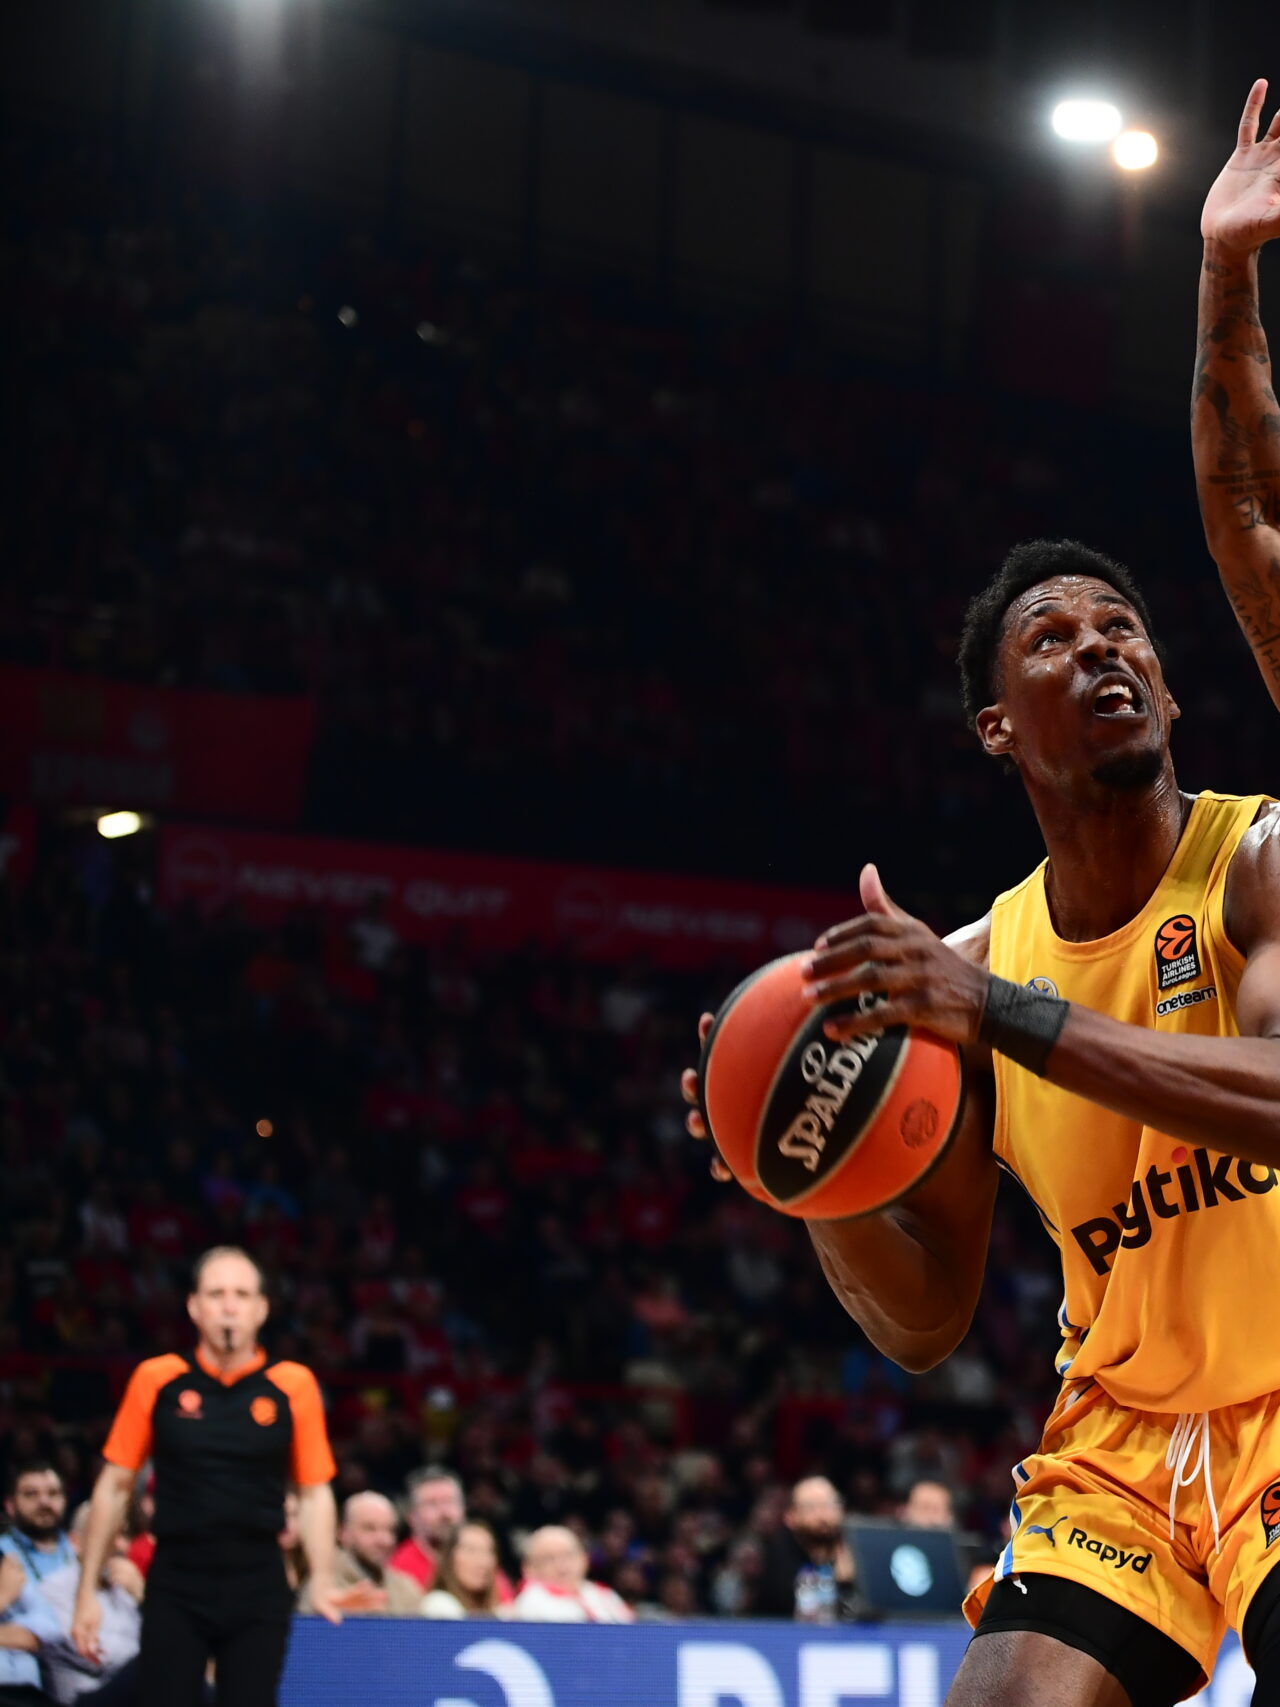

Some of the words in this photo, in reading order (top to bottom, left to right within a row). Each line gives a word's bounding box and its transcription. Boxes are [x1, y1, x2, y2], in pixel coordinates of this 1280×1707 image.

[1162, 954, 1195, 973] TURKISH
[1162, 962, 1197, 980] AIRLINES
[1162, 970, 1197, 987] EuroLeague
[1157, 987, 1217, 1014] oneteam
[1071, 1146, 1278, 1276] pytika
[1067, 1527, 1152, 1574] Rapyd
